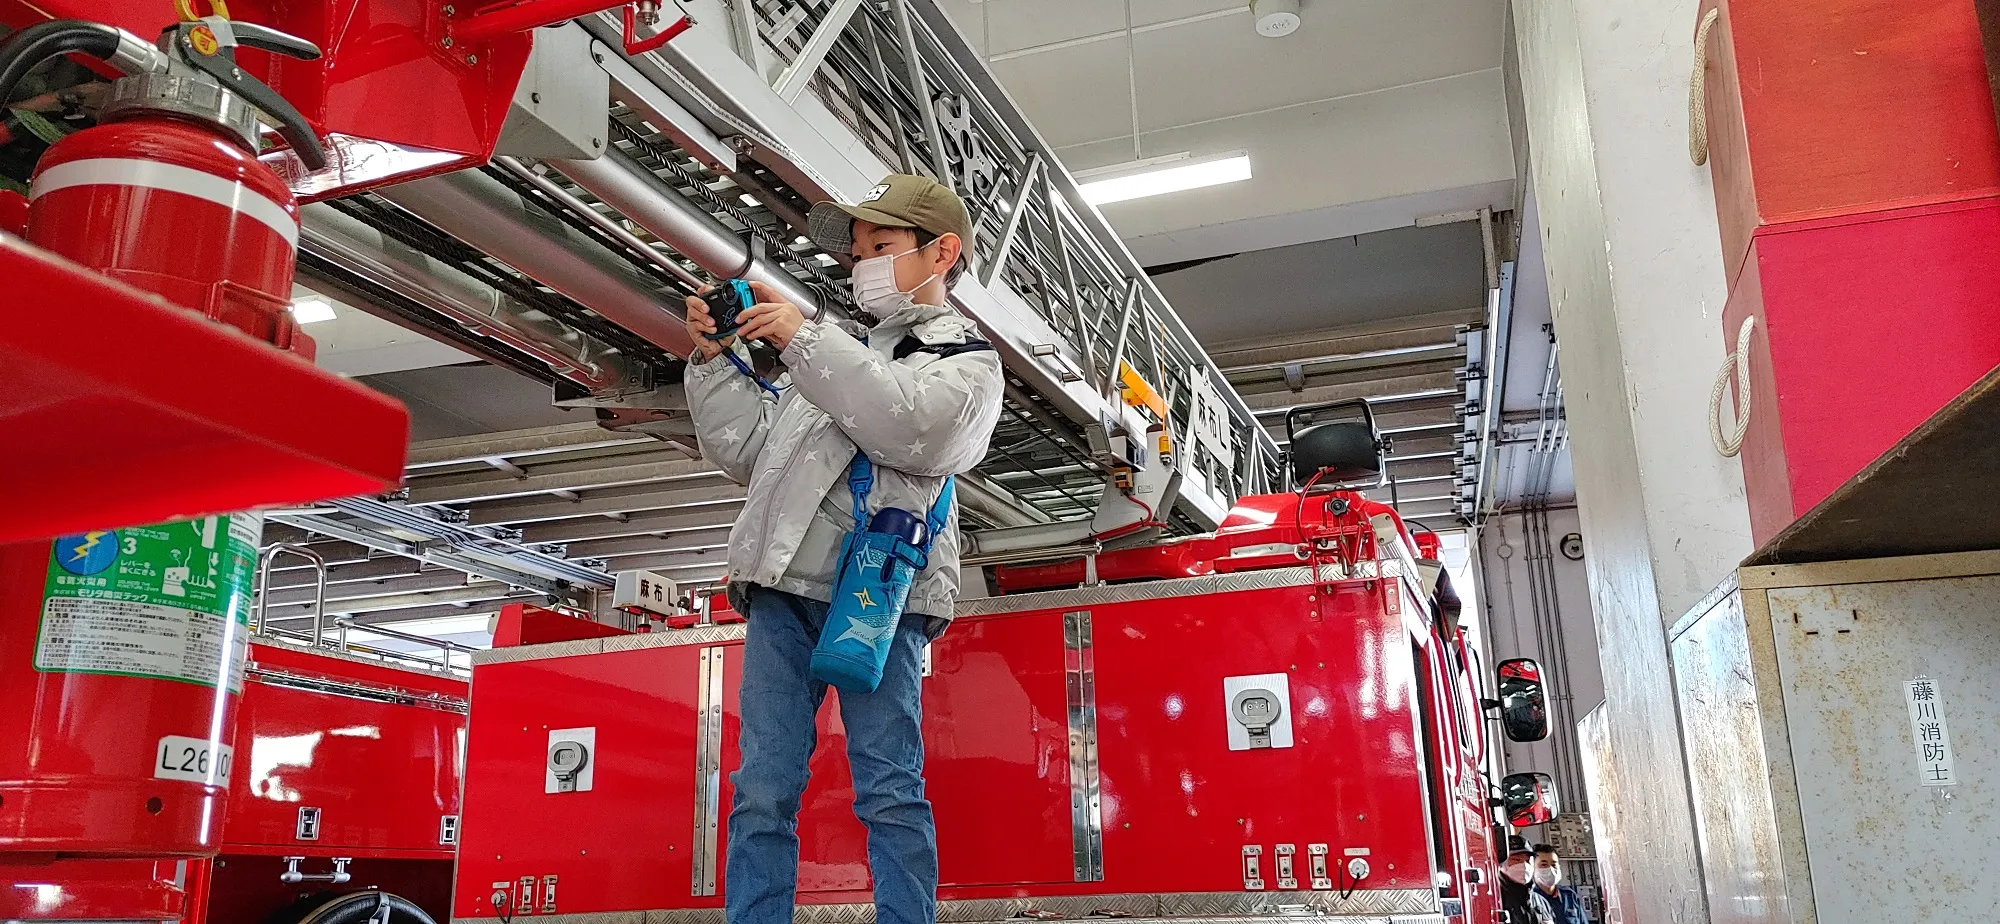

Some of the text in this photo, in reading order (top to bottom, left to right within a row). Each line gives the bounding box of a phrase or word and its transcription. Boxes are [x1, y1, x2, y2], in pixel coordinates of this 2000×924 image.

[122, 537, 137, 555] 3
[120, 559, 151, 568] レバーを
[1911, 681, 1949, 781] 藤川消防士
